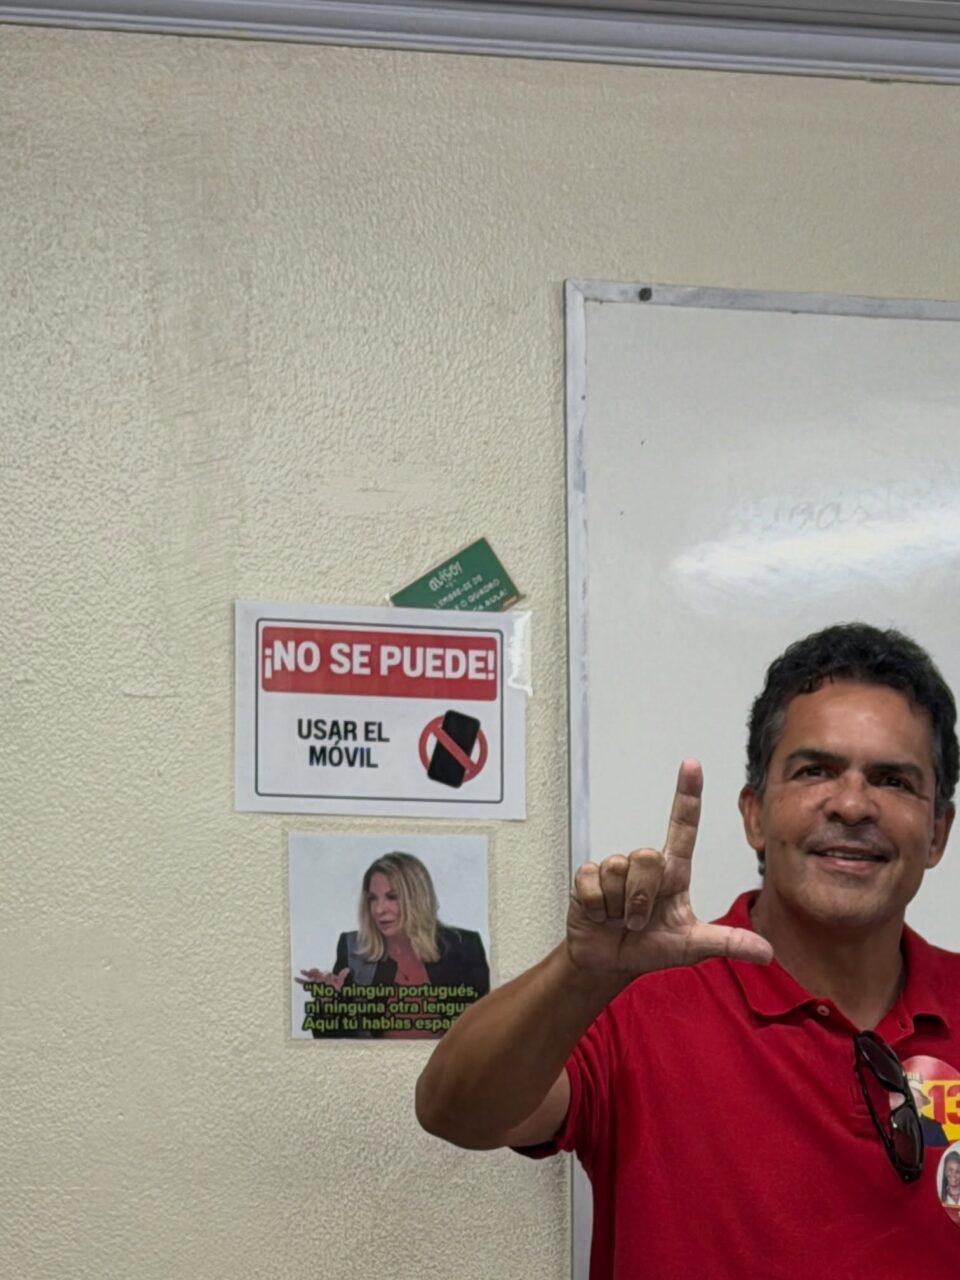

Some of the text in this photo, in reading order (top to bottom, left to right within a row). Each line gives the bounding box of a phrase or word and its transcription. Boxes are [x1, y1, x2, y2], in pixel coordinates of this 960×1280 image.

[263, 640, 495, 681] ¡NO SE PUEDE!
[297, 718, 390, 743] USAR EL
[308, 740, 378, 768] MÓVIL
[343, 984, 394, 1001] ningún
[399, 985, 478, 1001] portugués,
[306, 1001, 320, 1013] ni
[324, 1001, 385, 1016] ninguna
[389, 1003, 419, 1013] otra
[303, 1017, 339, 1031] Aquí
[342, 1017, 358, 1029] tú
[363, 1017, 411, 1029] hablas
